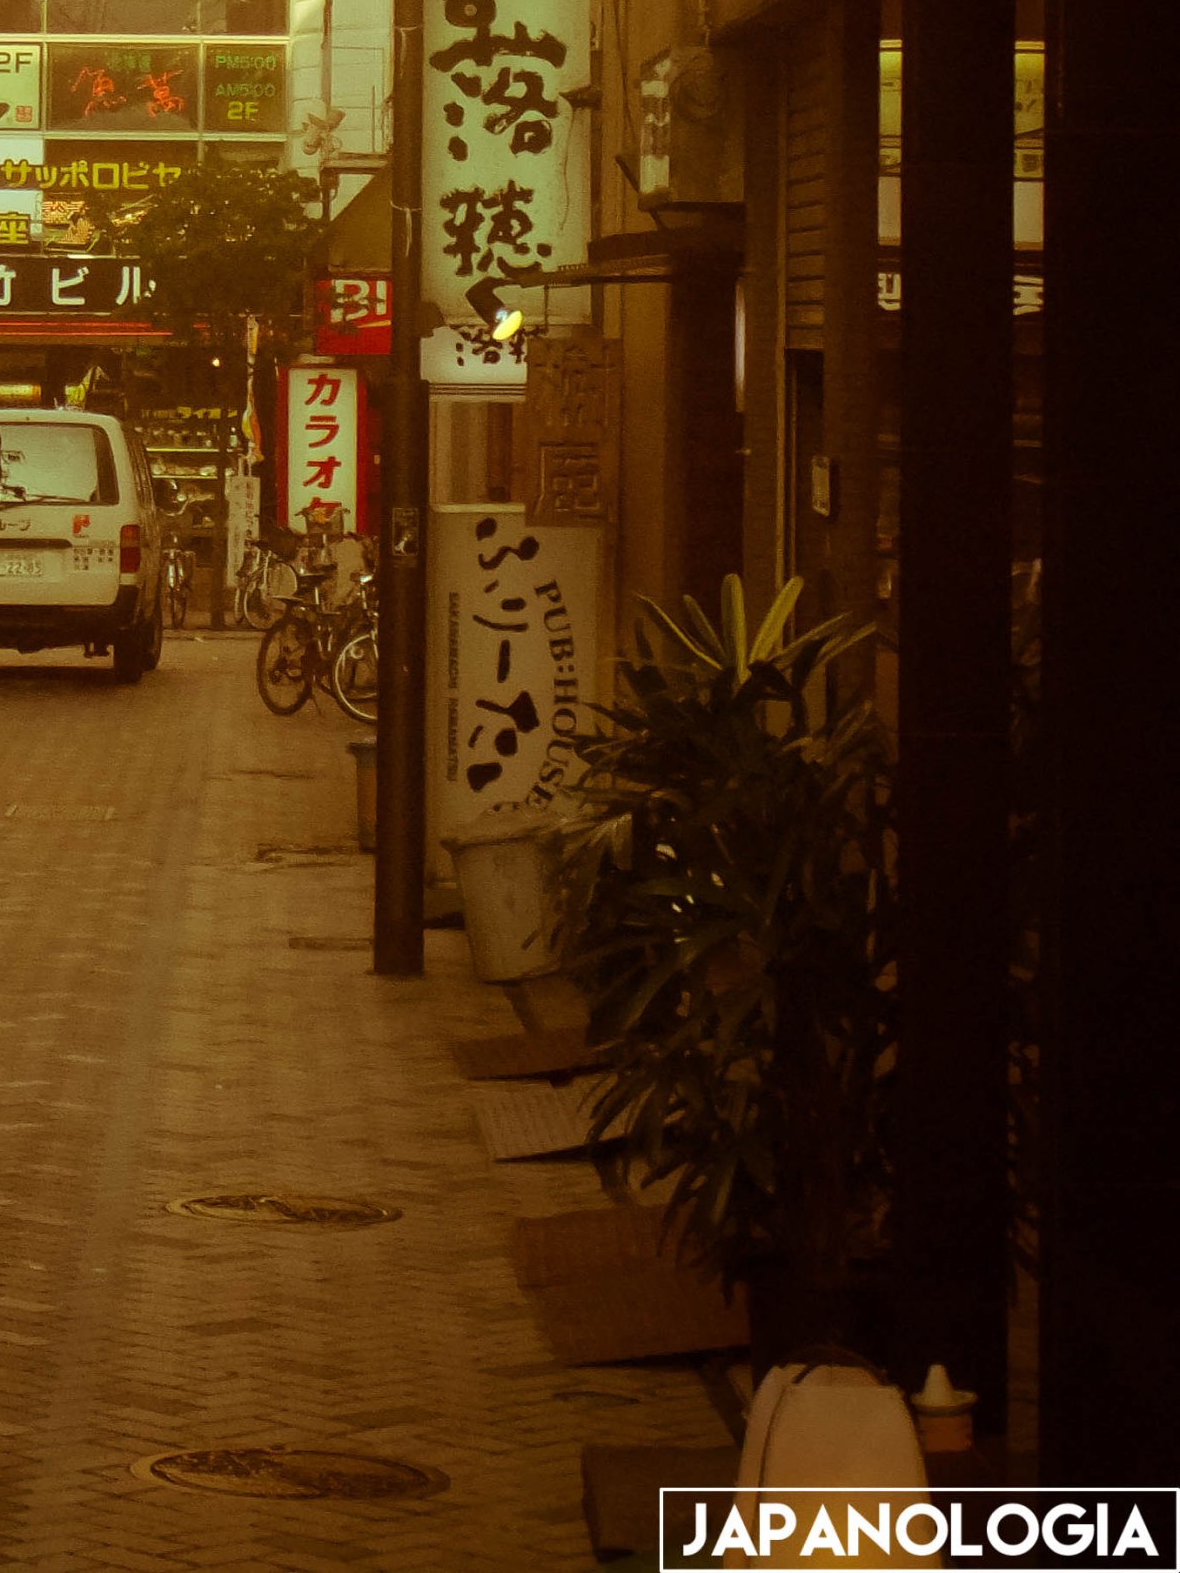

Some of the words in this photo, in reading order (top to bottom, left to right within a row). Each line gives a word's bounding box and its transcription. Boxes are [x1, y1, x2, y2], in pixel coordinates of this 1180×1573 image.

[216, 55, 277, 70] PM5:00
[216, 84, 277, 97] AM5:00
[227, 101, 259, 120] 2F
